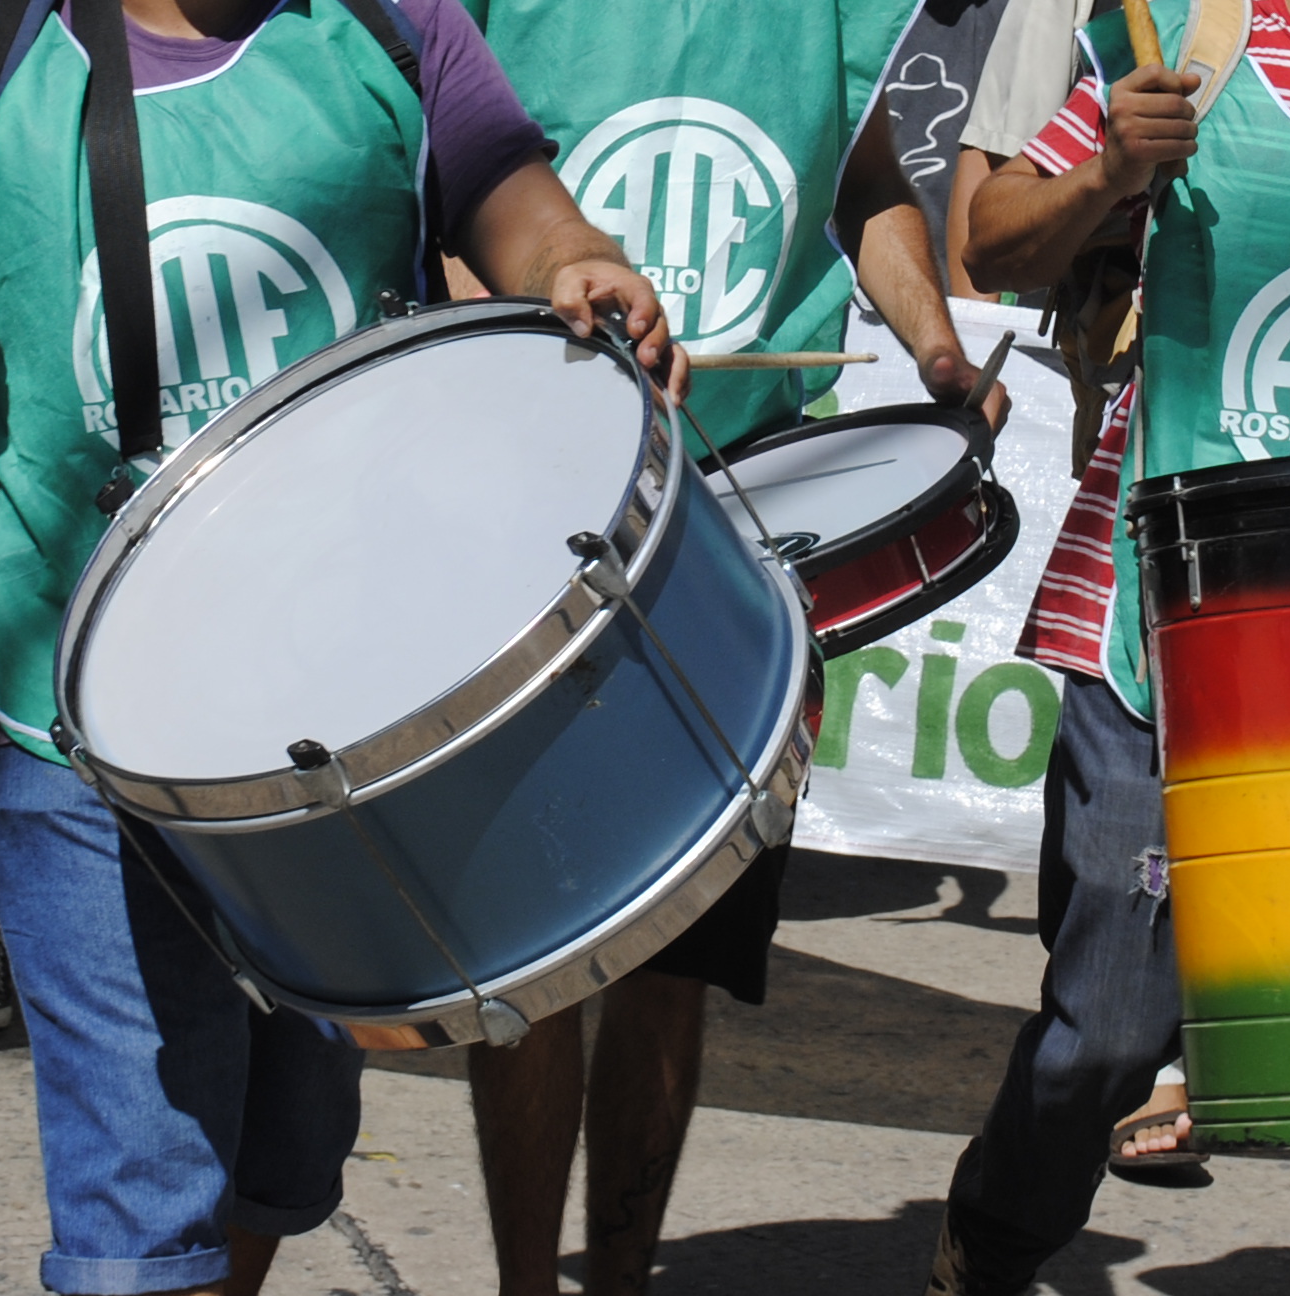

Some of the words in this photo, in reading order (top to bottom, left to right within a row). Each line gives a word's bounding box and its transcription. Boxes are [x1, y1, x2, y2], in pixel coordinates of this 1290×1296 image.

[580, 124, 772, 336] ATE
[640, 265, 703, 296] RIO
[81, 376, 253, 434] ROARIO
[811, 619, 1063, 789] rio
